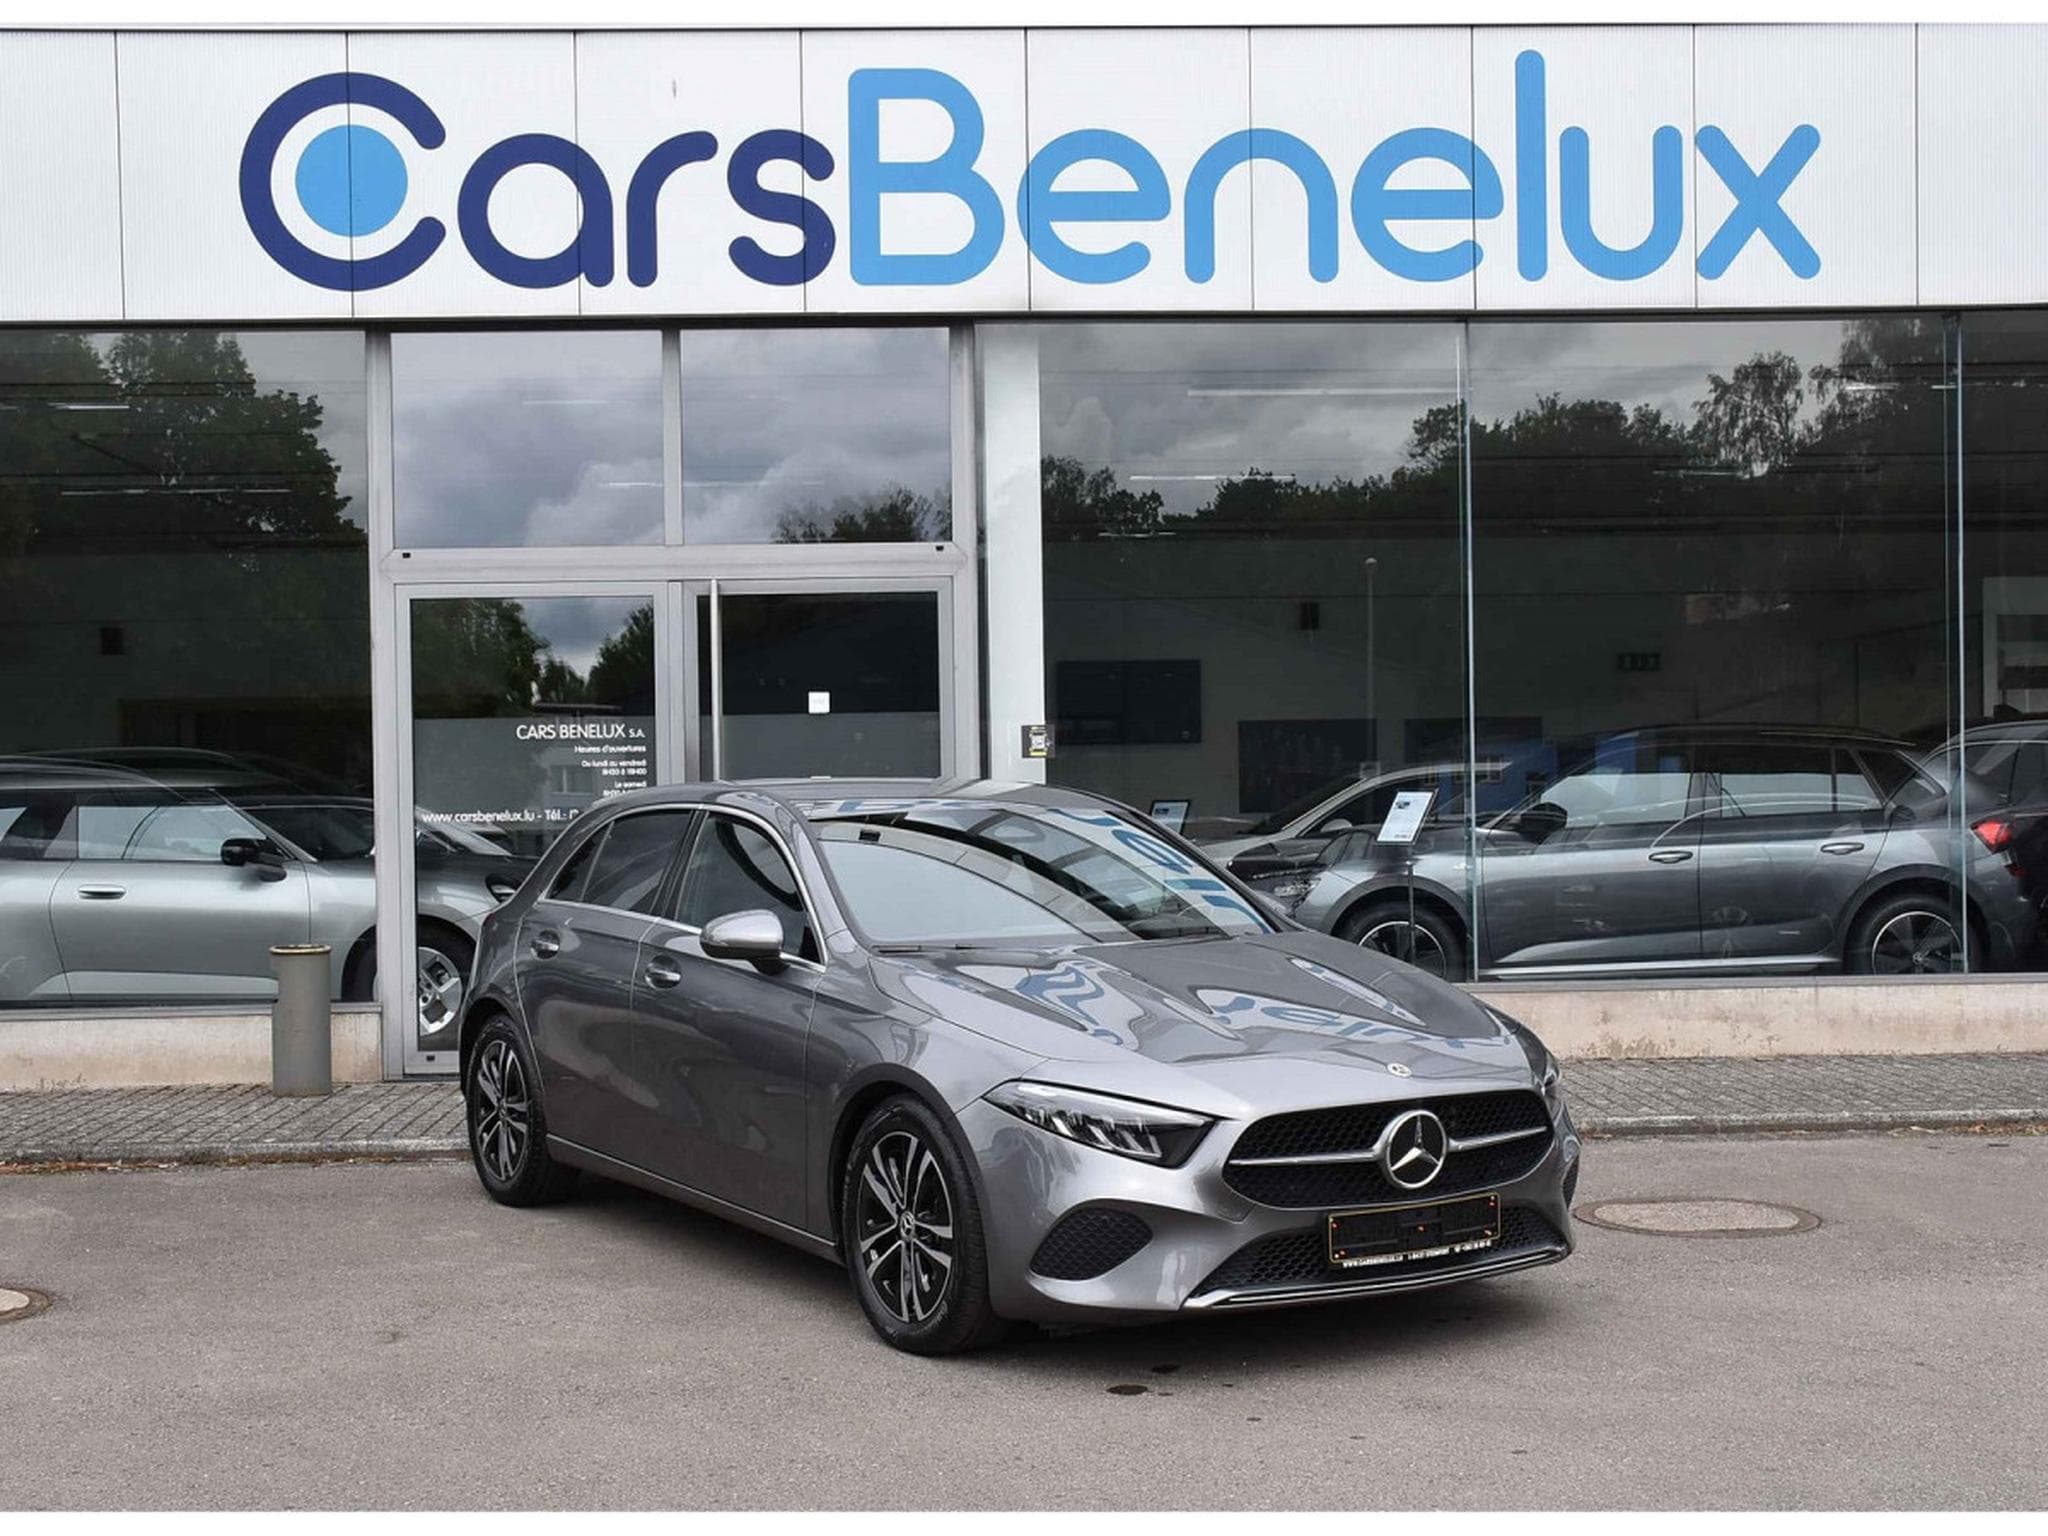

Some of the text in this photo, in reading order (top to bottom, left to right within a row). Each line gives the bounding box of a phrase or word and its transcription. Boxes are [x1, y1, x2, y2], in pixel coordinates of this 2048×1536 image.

[516, 725, 556, 740] CARS
[559, 724, 626, 739] BENELUX
[574, 745, 600, 753] Heures
[421, 808, 535, 823] www.carsbenelux.lu
